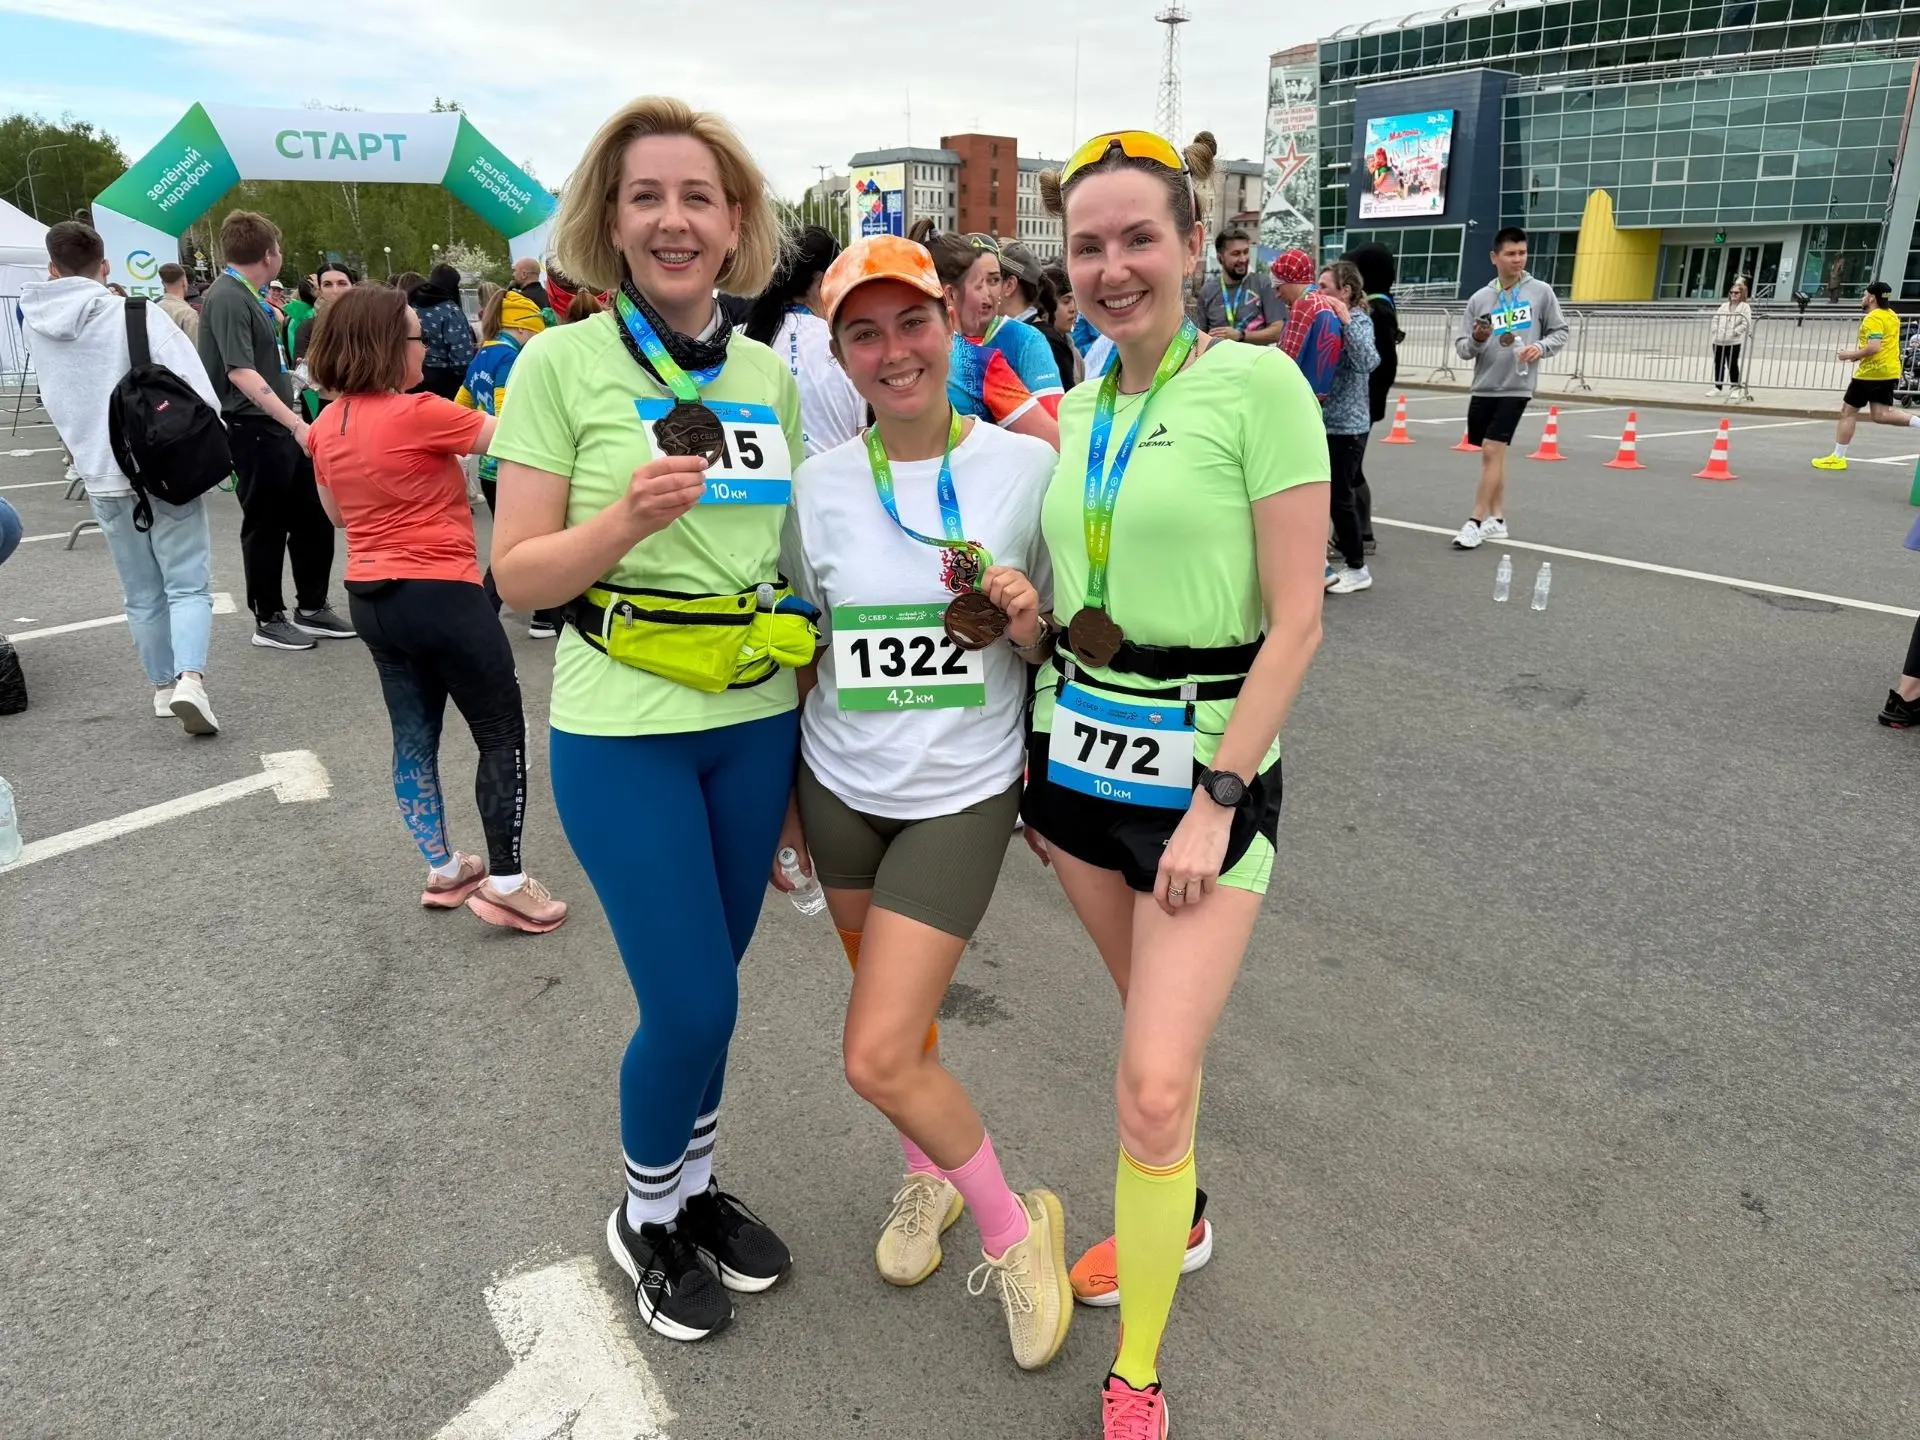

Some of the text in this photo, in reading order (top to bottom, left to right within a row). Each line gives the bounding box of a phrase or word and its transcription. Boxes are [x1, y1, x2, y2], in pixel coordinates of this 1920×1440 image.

[275, 129, 407, 162] СТАРТ
[146, 146, 202, 201] зелёный
[158, 160, 213, 212] марафон
[467, 165, 524, 214] марафон
[475, 155, 532, 205] зелёный
[790, 333, 798, 376] БЕГУ
[1138, 440, 1175, 448] DEMIX
[711, 484, 730, 499] 10
[1088, 476, 1096, 498] СБЕР
[1105, 488, 1115, 511] СБЕР
[850, 636, 968, 678] 1322
[887, 689, 914, 707] 4,2
[1074, 721, 1160, 776] 772
[514, 788, 523, 827] ЛЮБЛЮ
[1094, 780, 1112, 796] 10
